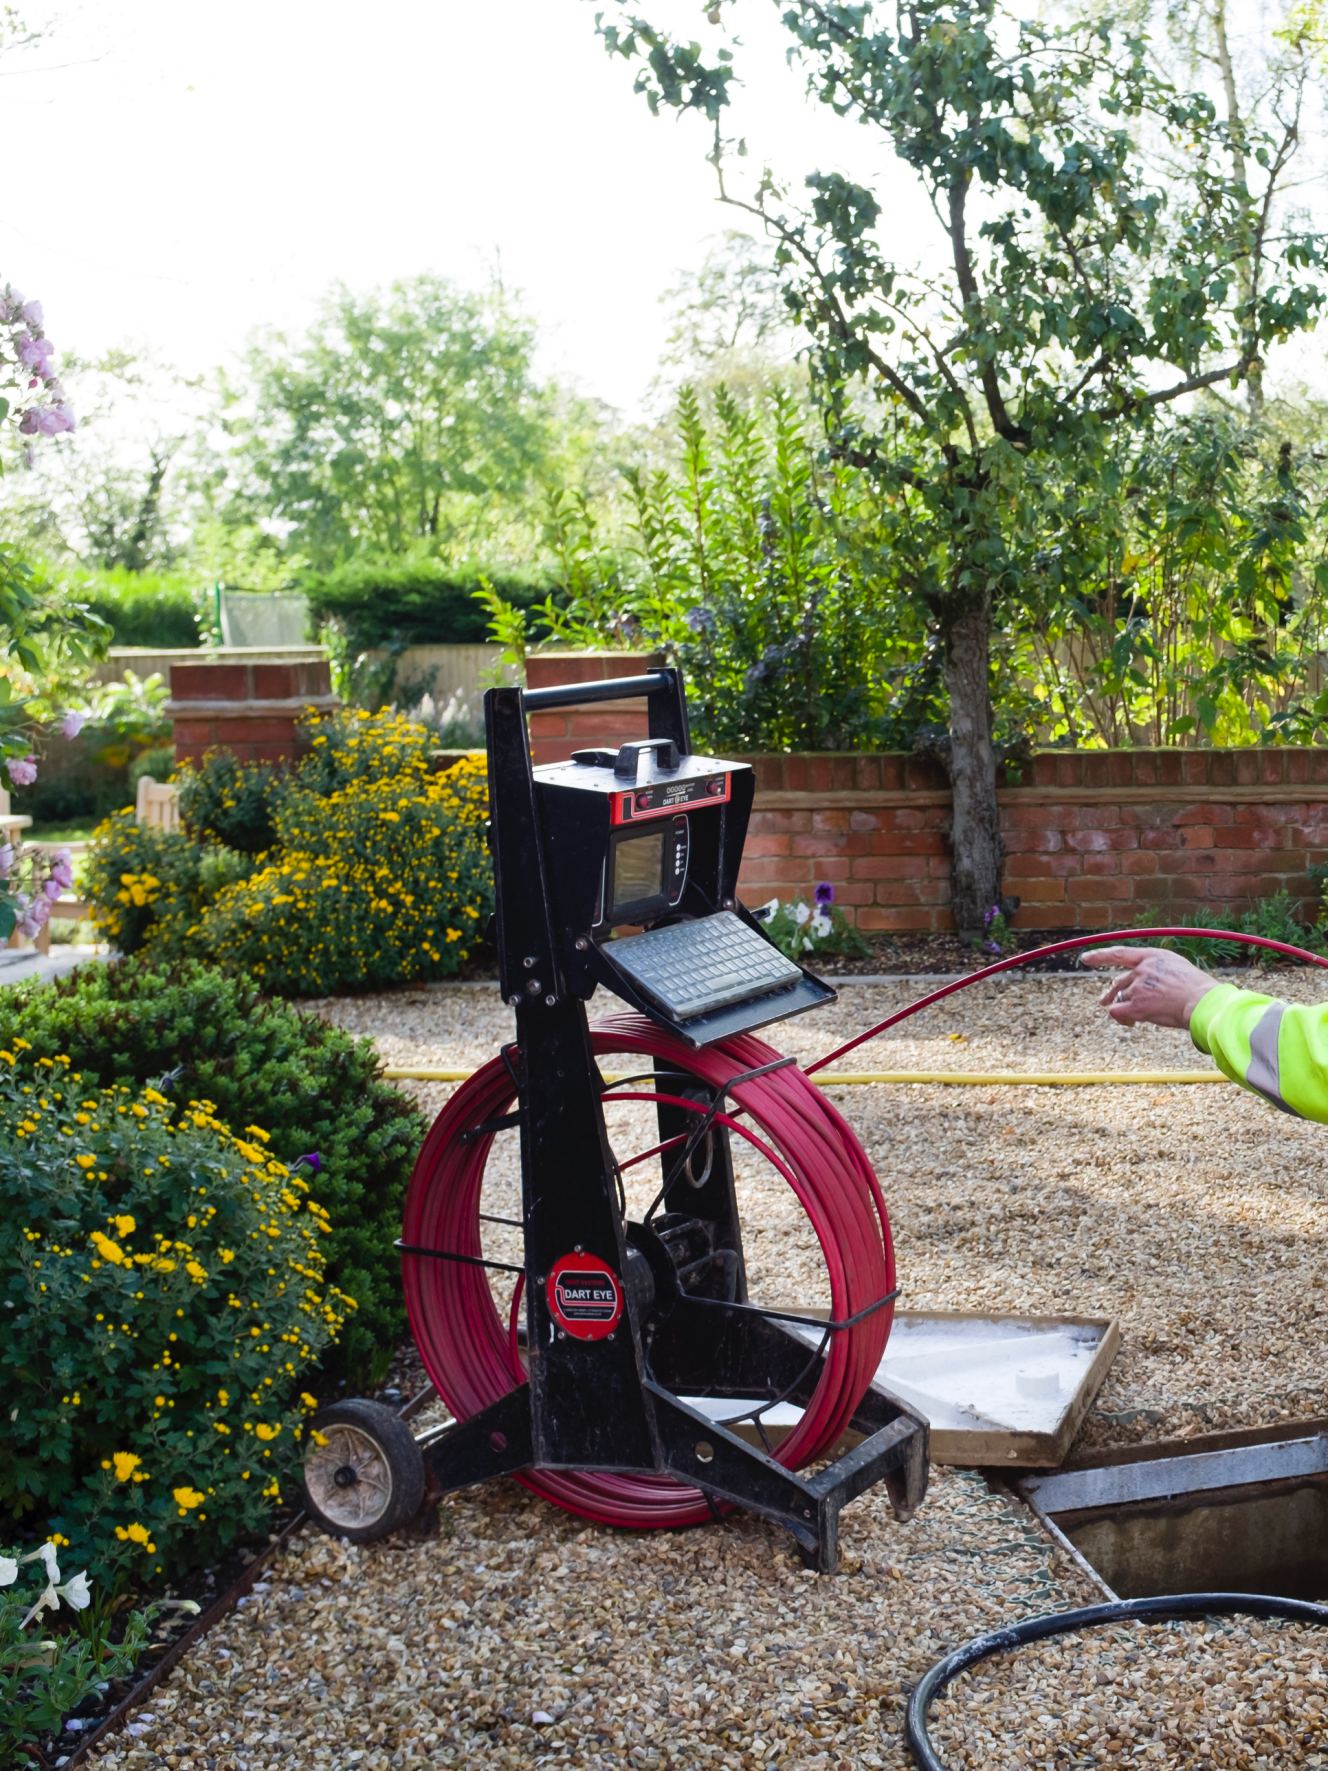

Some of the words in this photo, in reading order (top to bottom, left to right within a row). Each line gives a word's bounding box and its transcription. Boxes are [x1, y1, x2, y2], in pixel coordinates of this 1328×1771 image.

[662, 798, 675, 806] DART
[564, 1289, 591, 1299] DART
[593, 1290, 614, 1300] EYE
